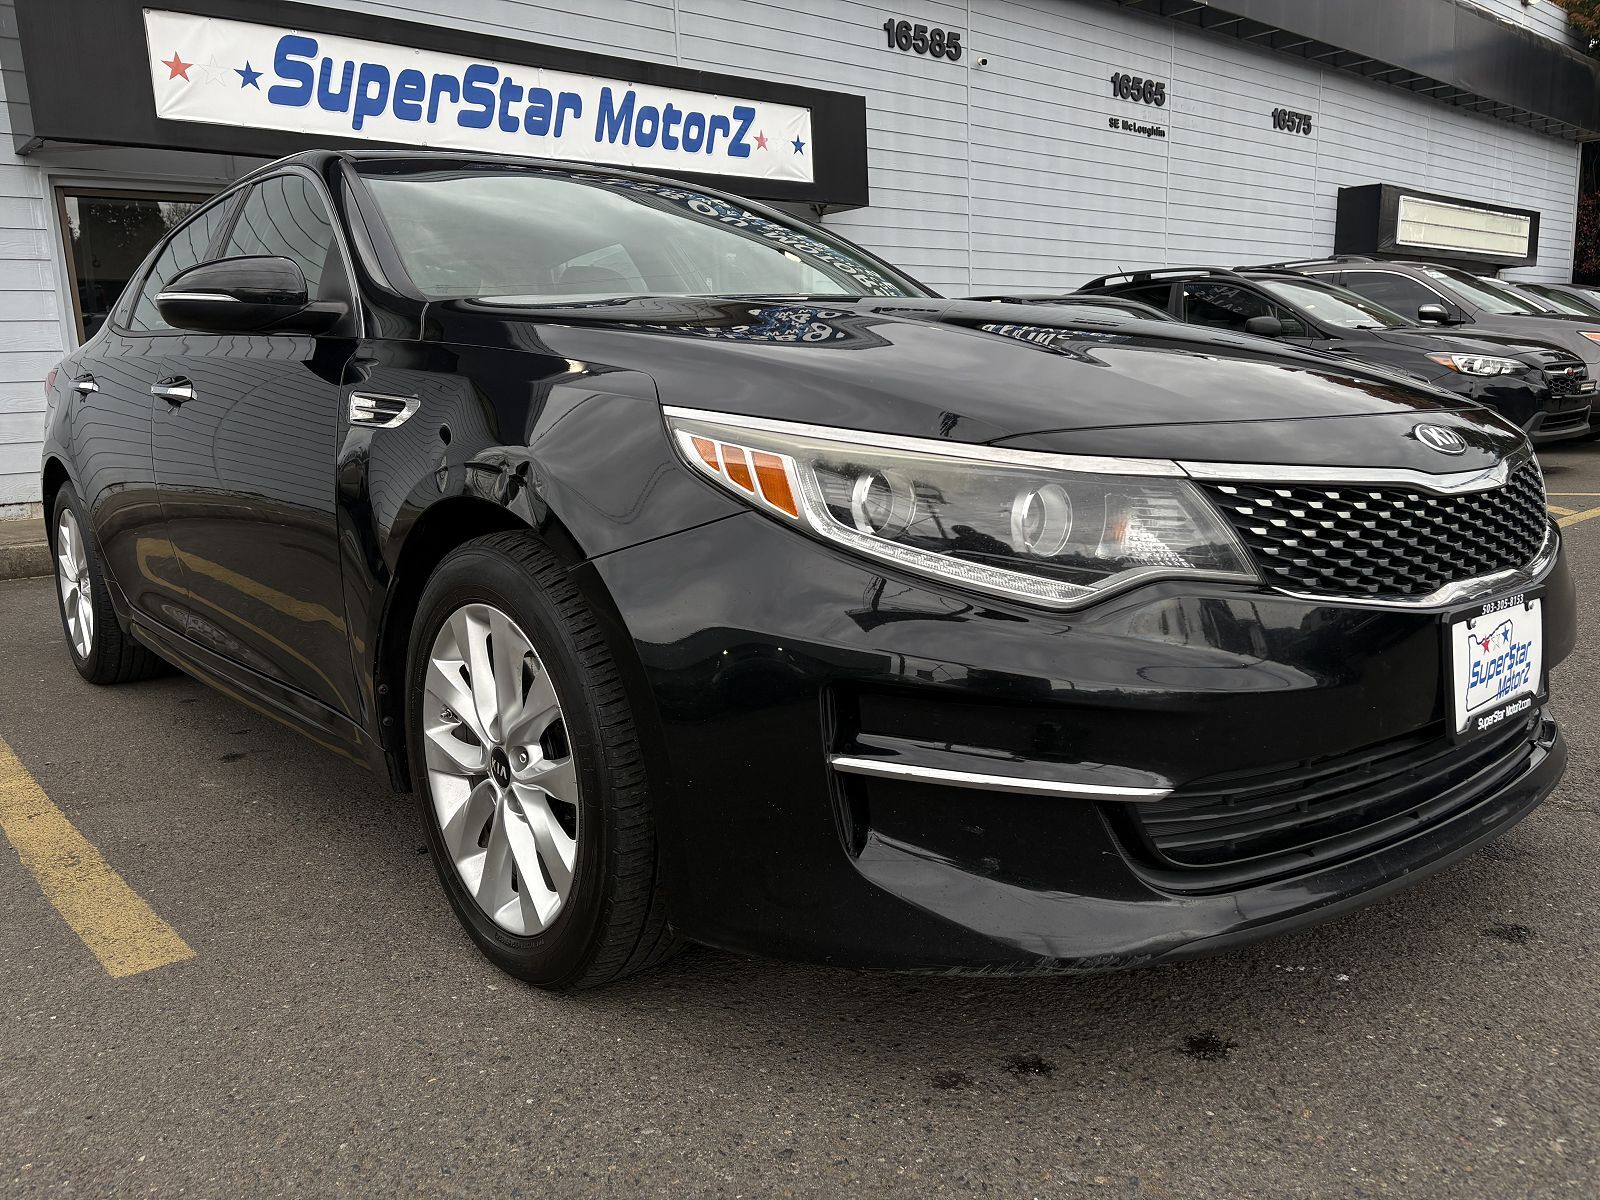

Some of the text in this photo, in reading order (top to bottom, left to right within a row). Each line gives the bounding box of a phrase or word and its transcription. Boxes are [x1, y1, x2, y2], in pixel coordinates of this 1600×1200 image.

[883, 17, 962, 61] 16585
[267, 34, 756, 158] SuperStar MotorZ
[1110, 72, 1166, 106] 16565
[1108, 117, 1166, 138] SE McLoughlin
[1271, 107, 1312, 135] 16575
[1421, 426, 1464, 446] KIA
[1482, 594, 1524, 615] 503-305-8153
[1469, 640, 1532, 689] SuperStar
[1496, 661, 1531, 701] MotorZ
[1477, 709, 1506, 730] SuperStar
[491, 756, 508, 780] KIA
